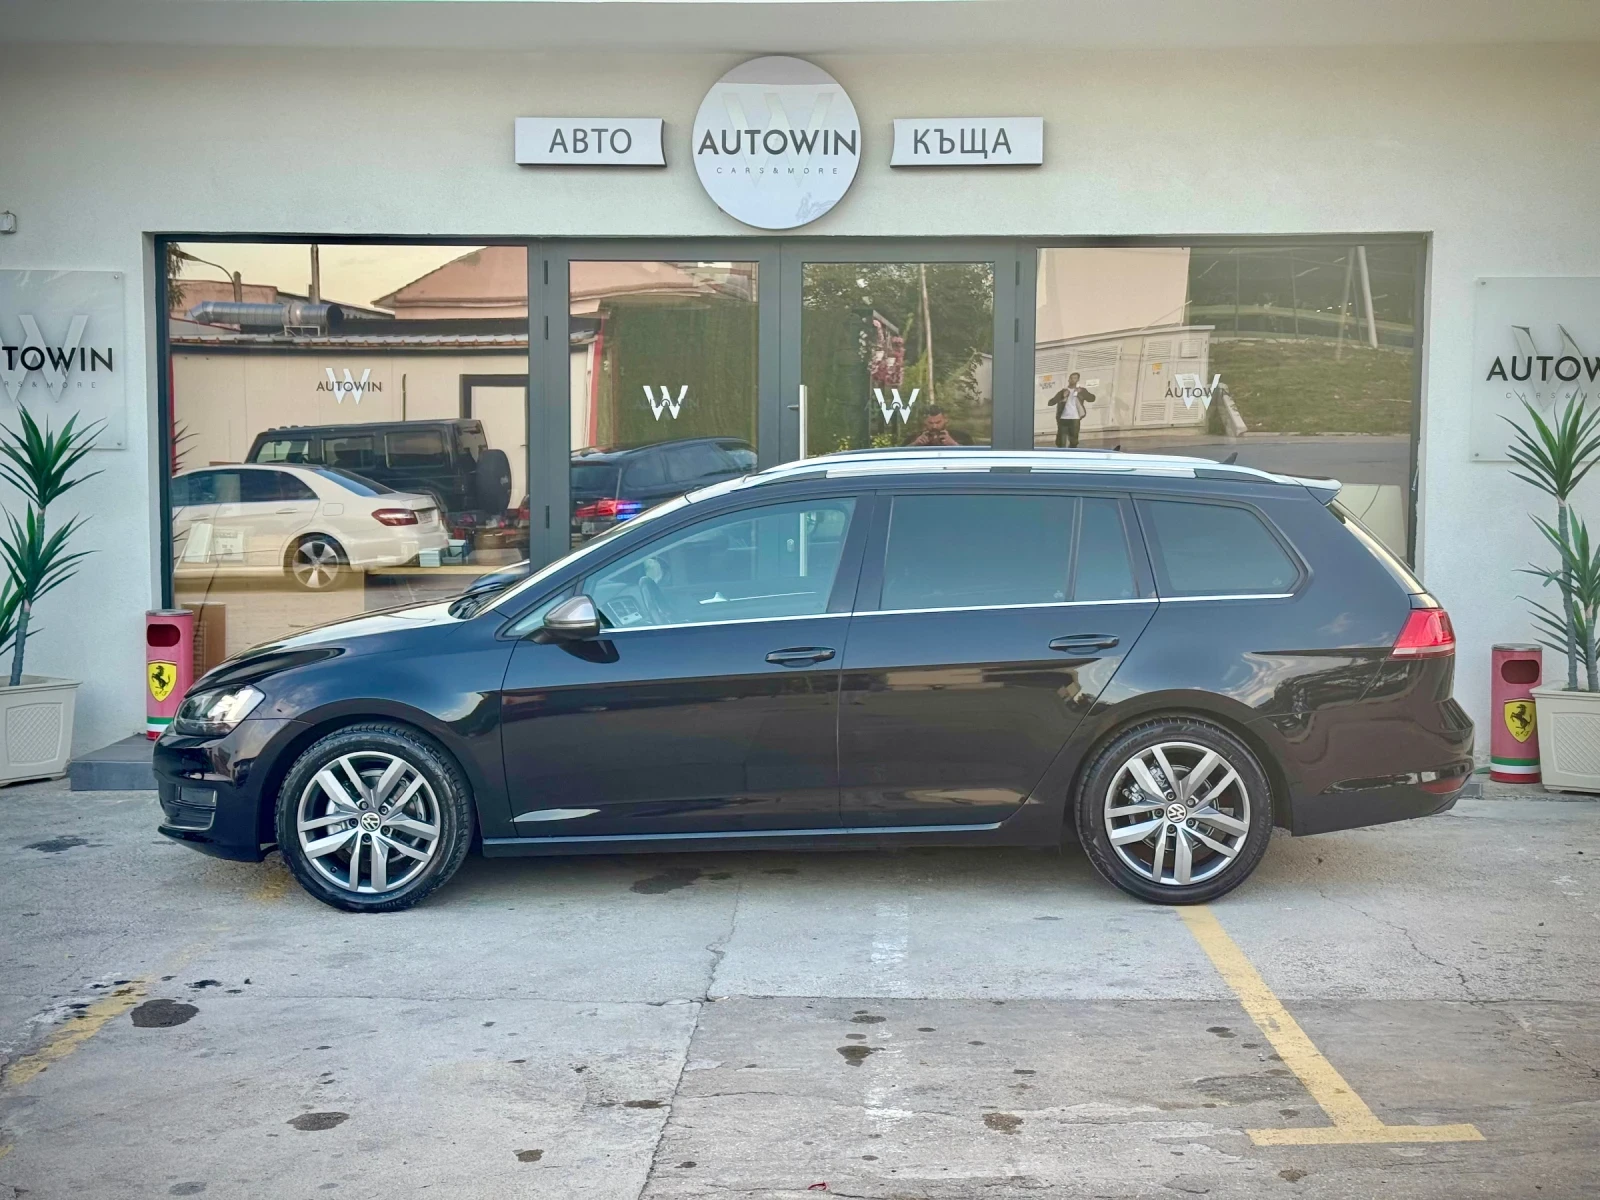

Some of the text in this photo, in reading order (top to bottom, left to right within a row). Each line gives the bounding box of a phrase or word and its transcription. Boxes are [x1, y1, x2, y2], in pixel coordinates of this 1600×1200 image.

[549, 128, 632, 154] АВТО
[698, 129, 856, 156] AUTOWIN
[914, 128, 1012, 159] КЪЩА
[1, 346, 113, 372] TOWIN
[316, 381, 382, 392] AUTOWIN
[1165, 387, 1233, 398] AUTOWN
